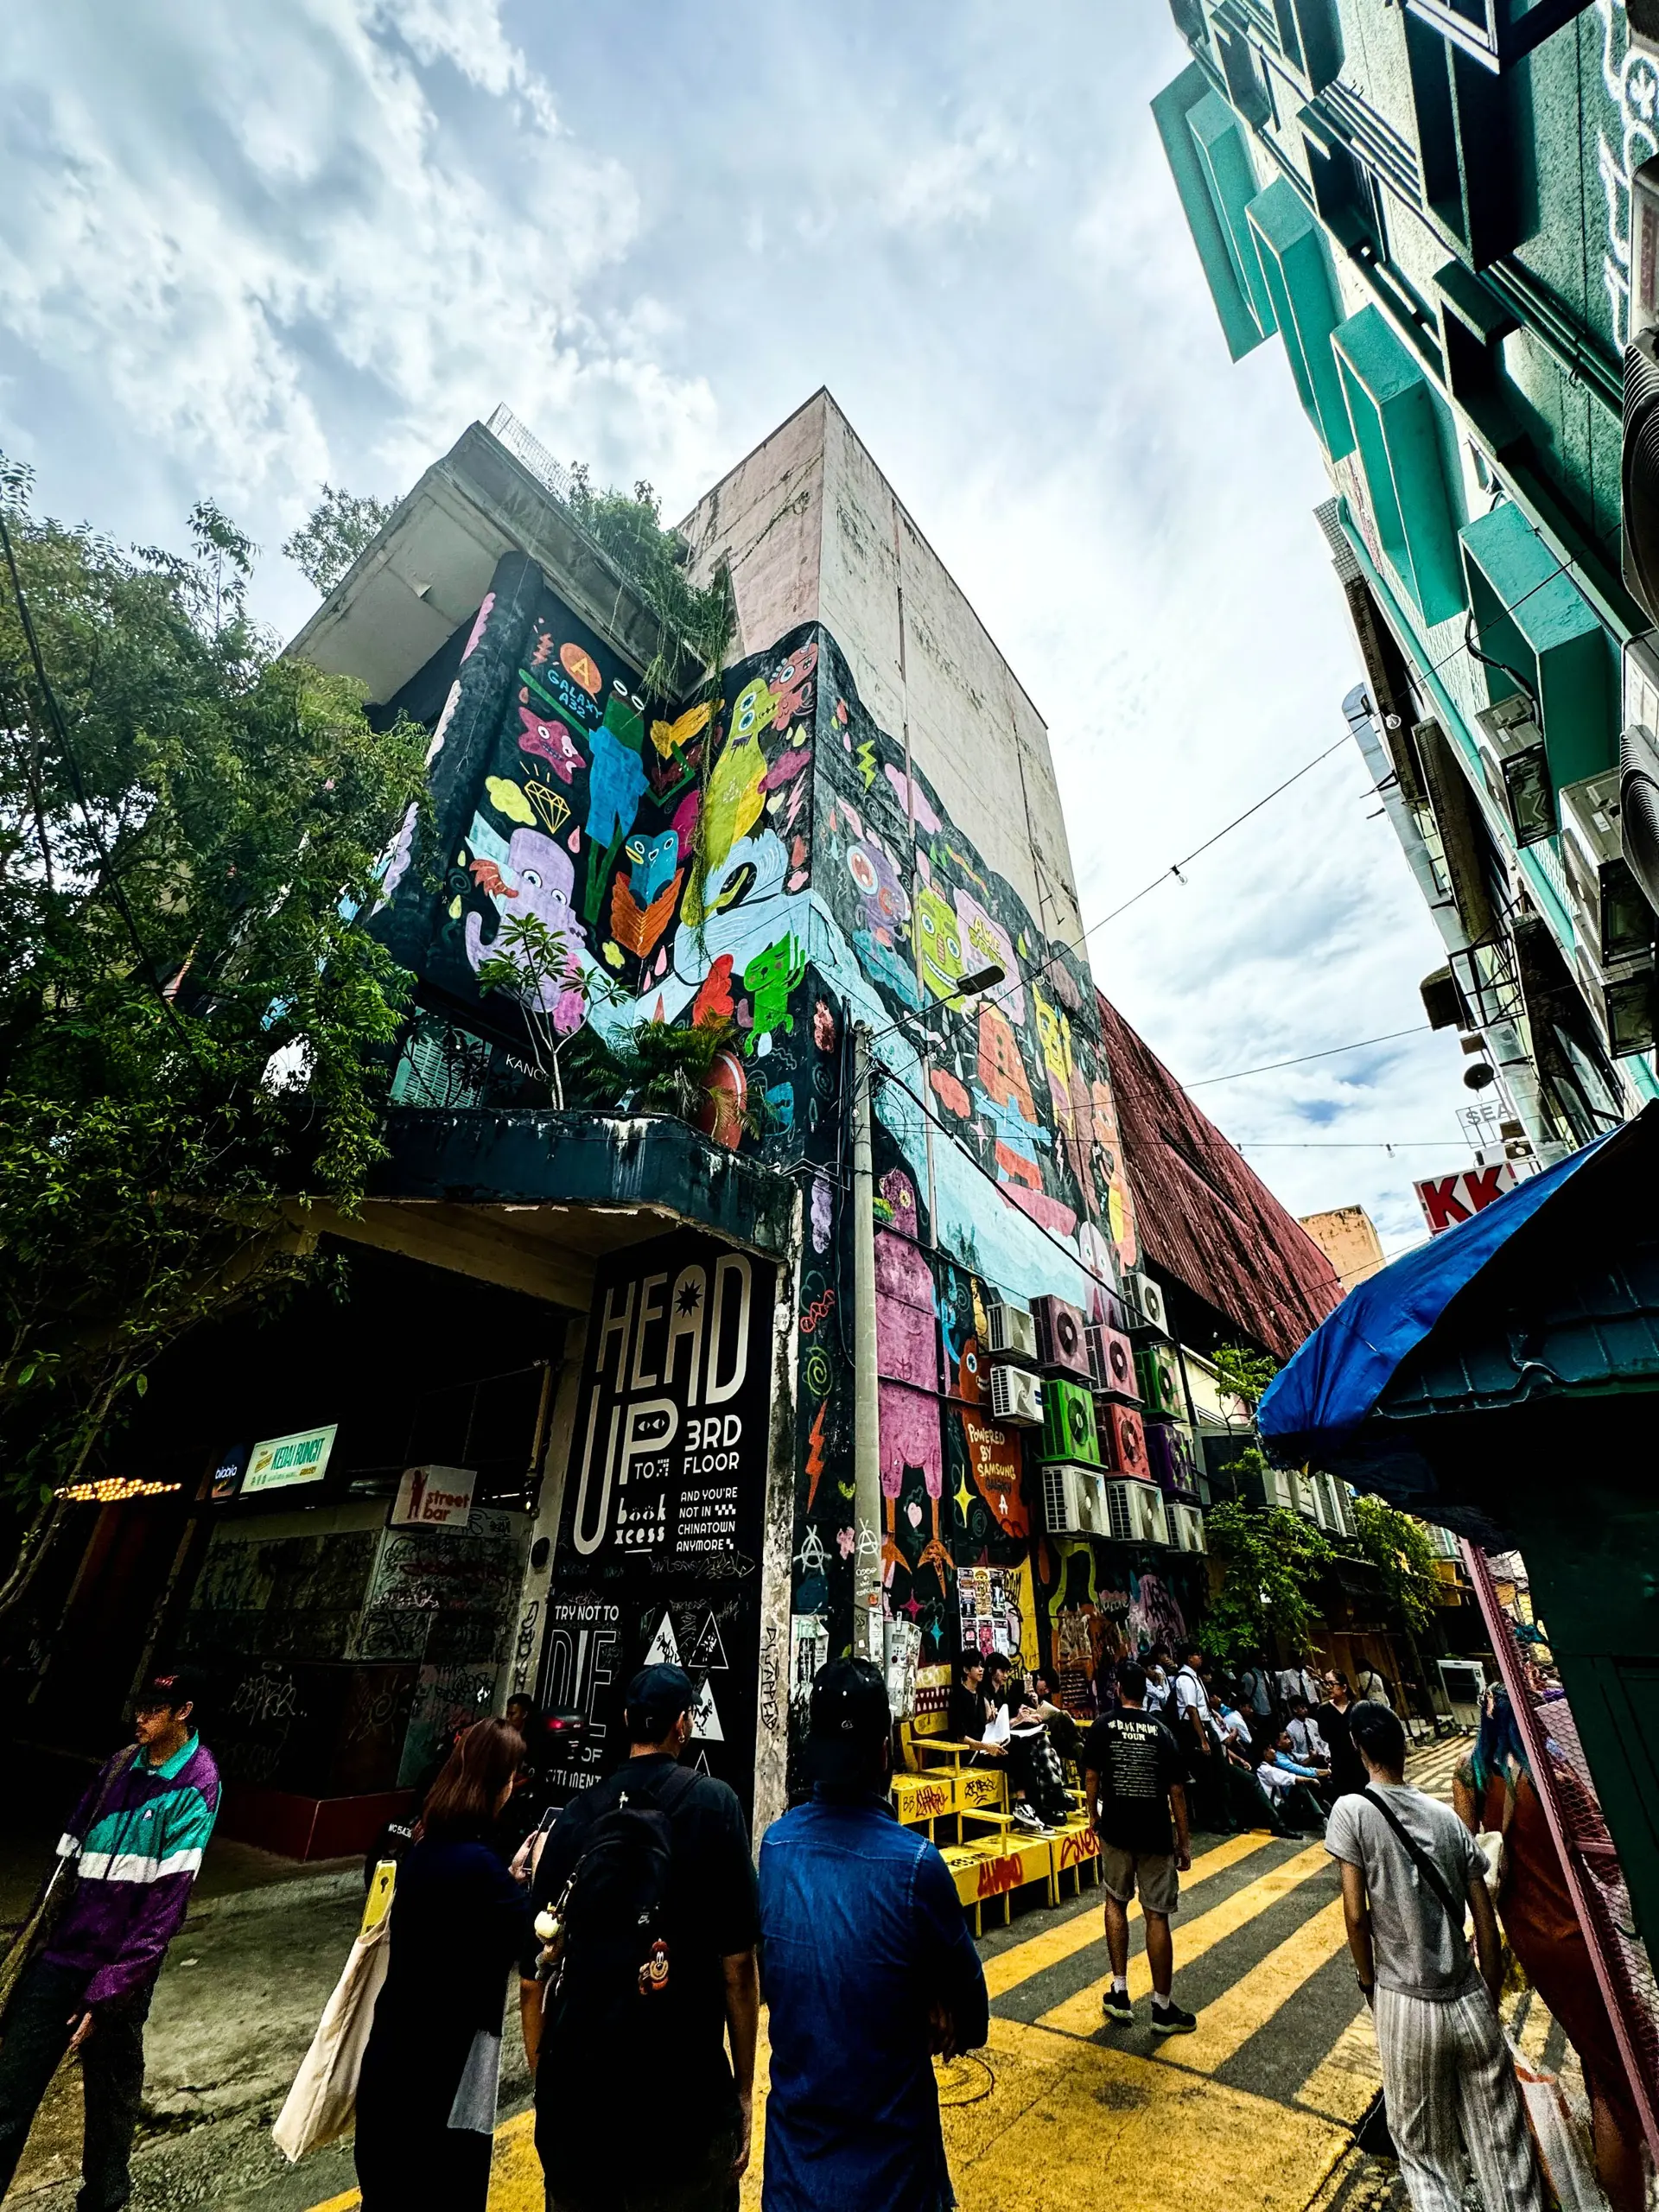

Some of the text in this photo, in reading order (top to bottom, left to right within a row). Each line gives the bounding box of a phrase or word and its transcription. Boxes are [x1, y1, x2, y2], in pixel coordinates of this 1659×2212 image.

[548, 670, 603, 719] GALAXY
[559, 692, 586, 719] A32
[595, 1253, 752, 1407] HEAD
[683, 1414, 742, 1452] 3RD
[967, 1423, 1006, 1446] POWERED
[979, 1445, 992, 1462] BY
[573, 1384, 678, 1554] UP
[634, 1461, 654, 1479] TO
[683, 1452, 740, 1475] FLOOR
[976, 1463, 1017, 1480] SAMSUNG
[426, 1491, 470, 1509] street
[680, 1486, 738, 1503] AND YOU'RE
[423, 1503, 451, 1521] bar
[678, 1505, 711, 1518] NOT IN
[677, 1520, 735, 1535] CHINATOWN
[676, 1538, 724, 1553] ANYMORE
[554, 1605, 620, 1621] TRY NOT TO
[1122, 1732, 1146, 1741] TOUR
